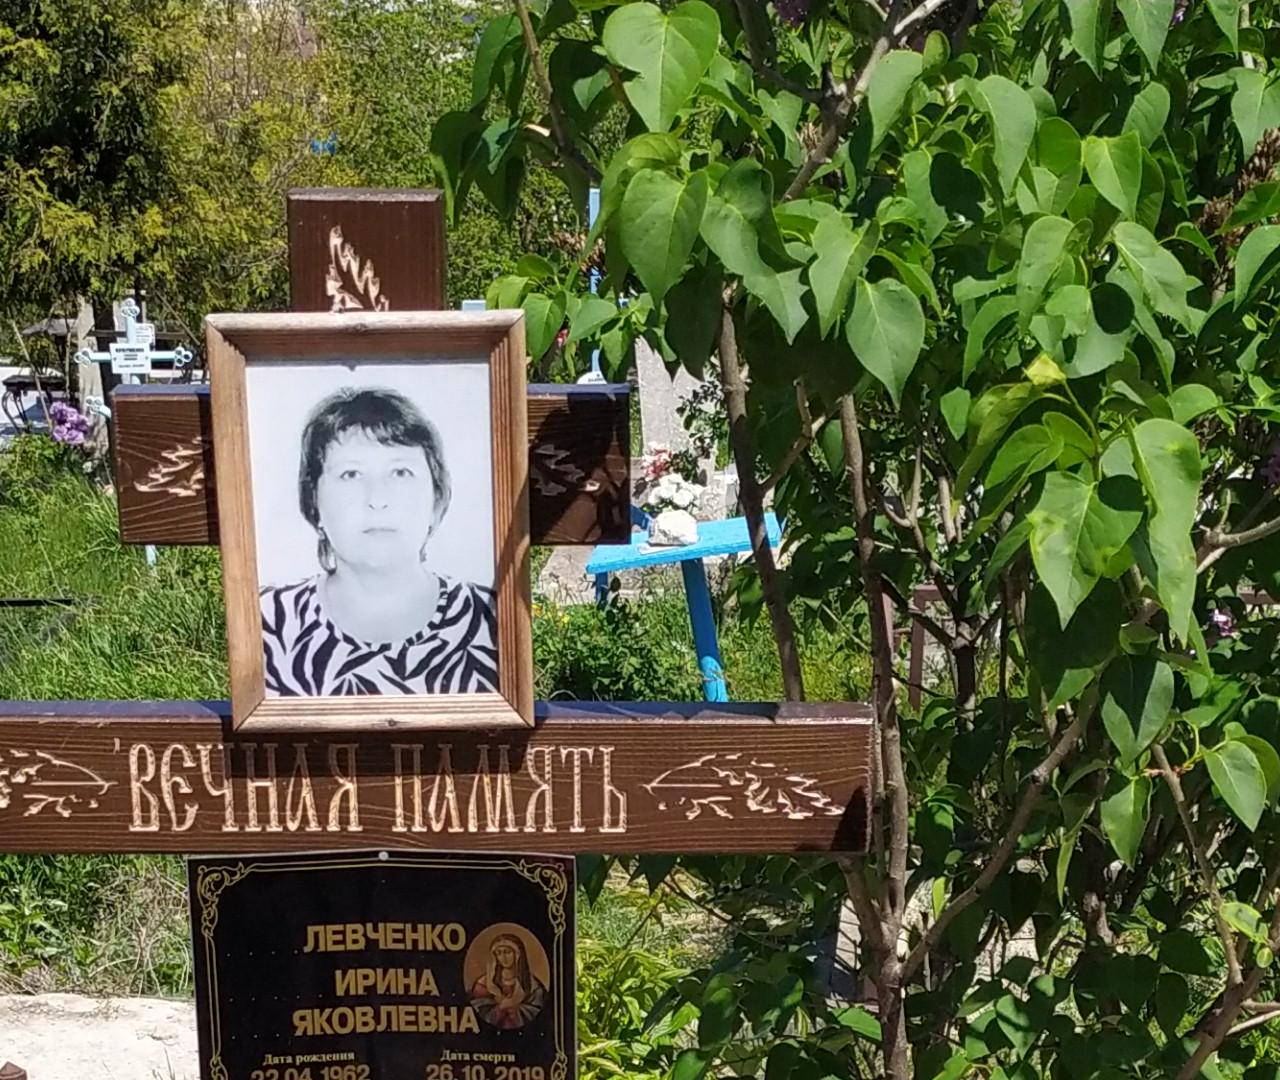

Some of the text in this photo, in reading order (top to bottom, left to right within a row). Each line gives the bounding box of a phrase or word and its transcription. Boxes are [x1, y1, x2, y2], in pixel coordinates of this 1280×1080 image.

[128, 743, 628, 833] ВЕЧНАЯ ПАМЯТЬ
[303, 921, 467, 953] ЛЕВЧЕНКО
[334, 967, 441, 997] ИРИНА
[291, 1004, 481, 1037] ЯКОВЛЕВНА
[262, 1050, 356, 1066] Дата рождения
[440, 1049, 516, 1064] Дата смерти
